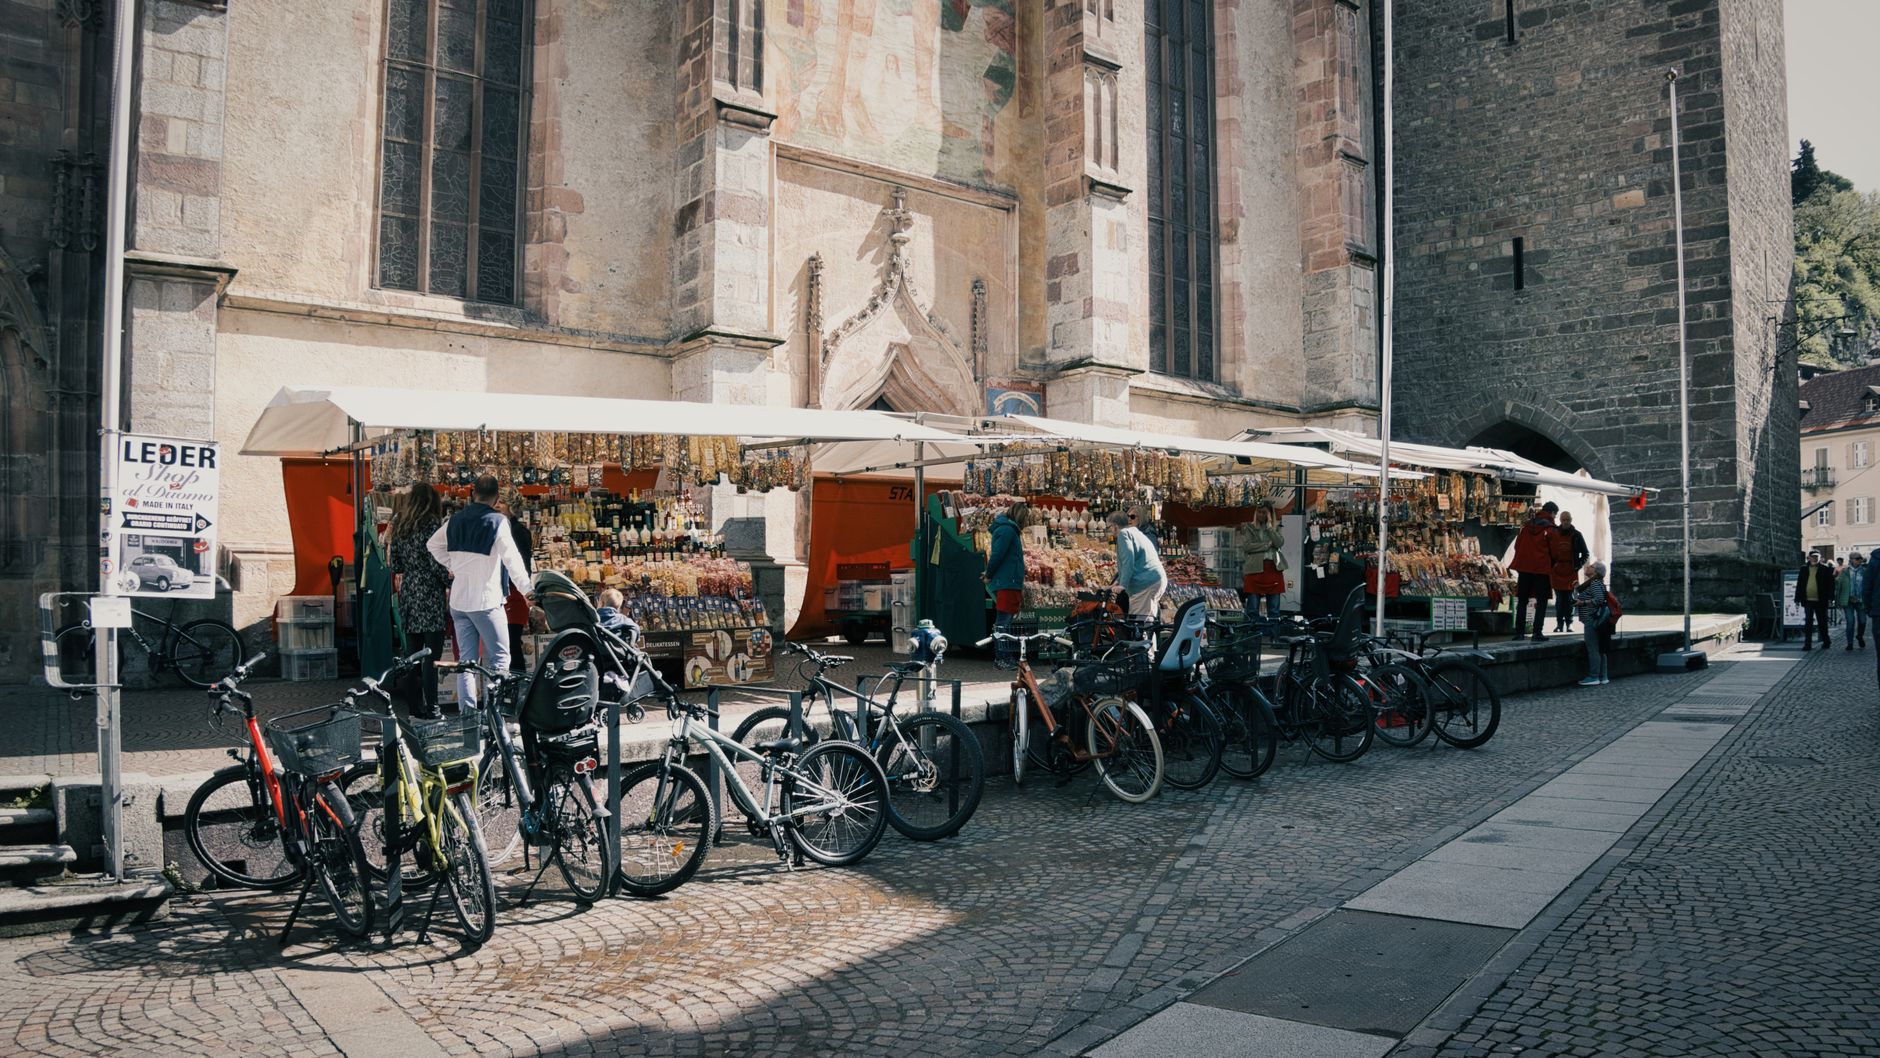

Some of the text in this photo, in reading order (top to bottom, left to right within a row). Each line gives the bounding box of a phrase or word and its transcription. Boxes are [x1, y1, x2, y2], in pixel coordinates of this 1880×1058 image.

[124, 441, 216, 469] LEDER
[135, 464, 200, 490] Shop
[122, 484, 214, 502] al Duomo
[143, 500, 194, 511] MADE IN ITALY
